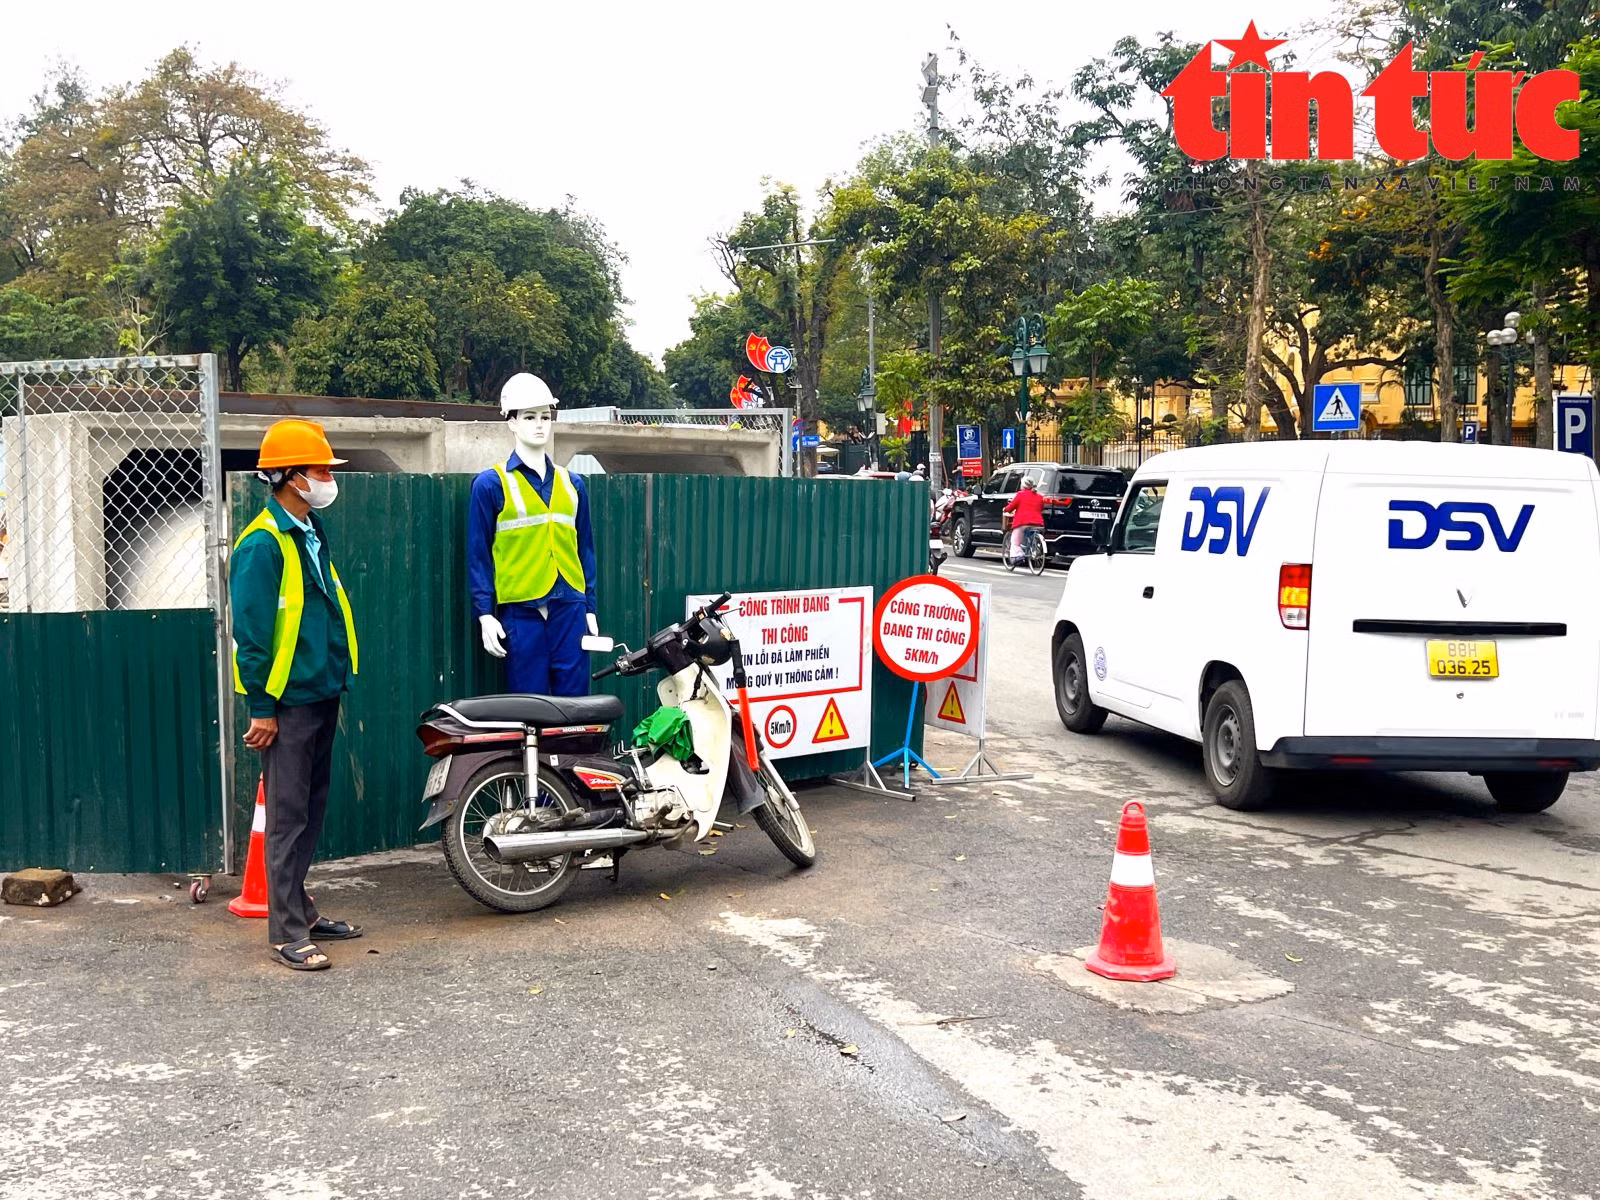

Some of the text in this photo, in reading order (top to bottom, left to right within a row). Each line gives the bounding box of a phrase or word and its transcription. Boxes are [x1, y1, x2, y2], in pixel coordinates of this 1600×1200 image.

[1465, 425, 1475, 438] P
[1564, 407, 1587, 449] P
[1181, 486, 1271, 557] DSV
[1388, 499, 1535, 552] DSV
[739, 595, 830, 617] CÔNG TRÌNH ĐANG
[890, 598, 966, 622] CÔNG TRƯỜNG
[762, 623, 809, 645] THI CÔNG
[883, 622, 966, 646] ĐANG THI CÔNG
[741, 653, 753, 666] IN
[771, 649, 783, 664] ĐÃ
[785, 647, 803, 663] LÀM
[1437, 660, 1491, 675] 036.25
[774, 672, 783, 688] VỊ
[785, 668, 813, 684] THÔNG
[814, 664, 833, 681] CẢM
